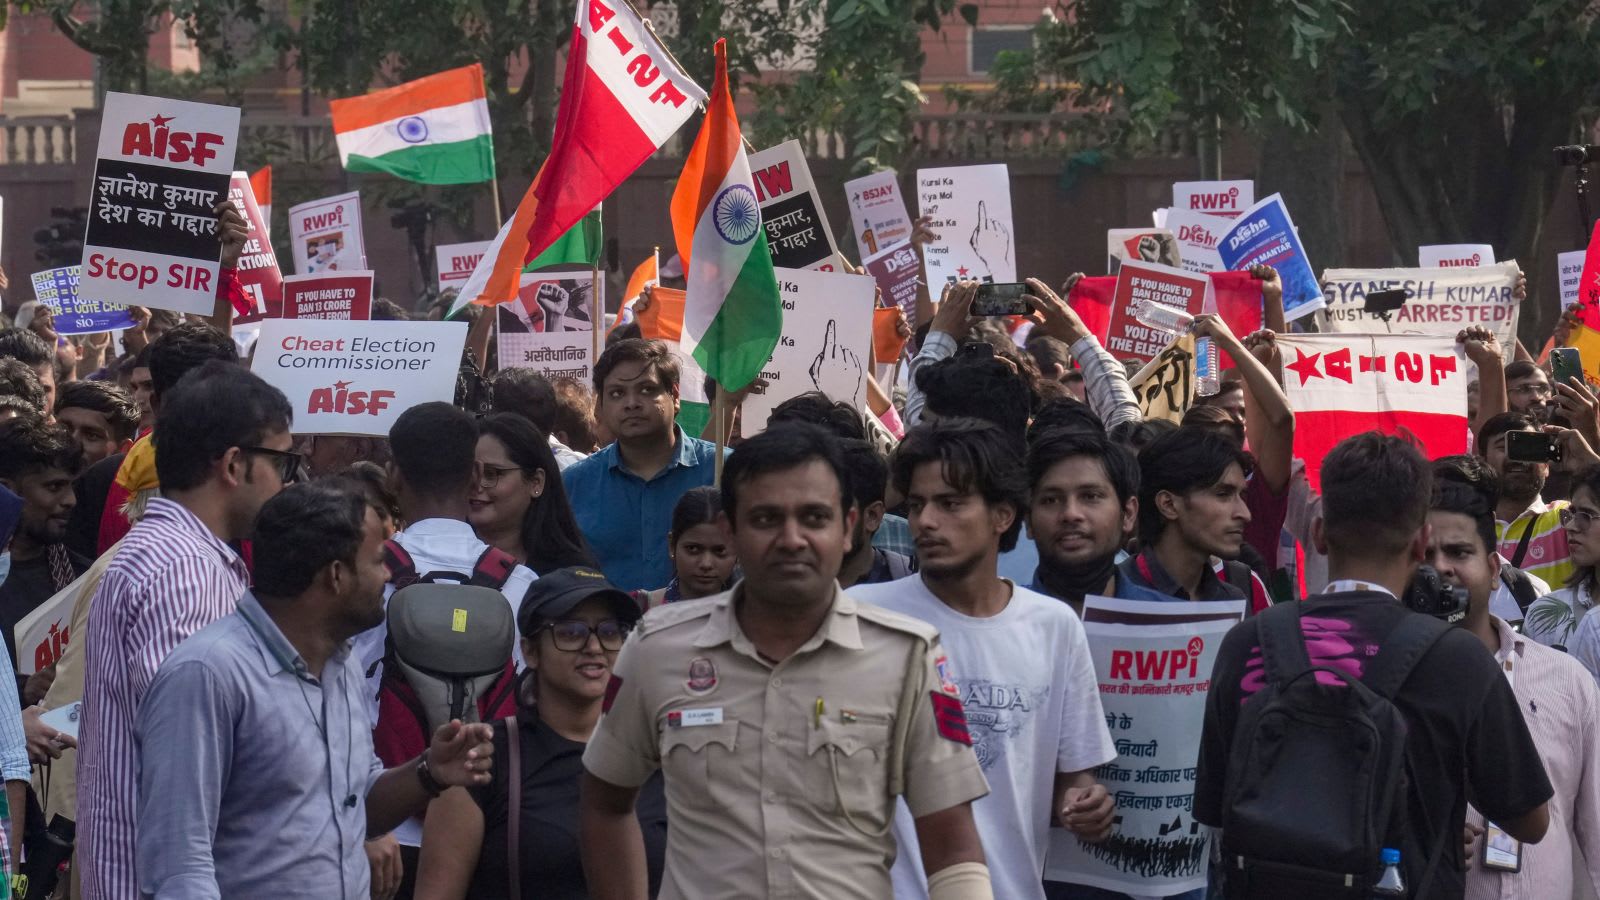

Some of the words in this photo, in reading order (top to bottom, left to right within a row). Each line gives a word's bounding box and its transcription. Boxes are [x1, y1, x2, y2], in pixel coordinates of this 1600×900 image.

[921, 178, 941, 187] Kursi
[942, 177, 953, 186] Ka
[98, 173, 158, 200] ज्ञानेश
[163, 184, 218, 209] कुमार
[922, 193, 937, 202] Kya
[939, 192, 953, 200] Mol
[98, 197, 132, 224] देश
[137, 207, 165, 228] का
[927, 220, 944, 228] anta
[946, 219, 957, 227] Ka
[926, 246, 949, 254] Anmol
[87, 253, 159, 289] Stop
[166, 263, 211, 292] SIR
[296, 292, 303, 302] IF
[304, 290, 319, 301] YOU
[320, 289, 343, 299] HAVE
[344, 288, 356, 298] TO
[785, 282, 798, 293] Ka
[1131, 277, 1140, 286] IF
[1140, 278, 1157, 290] YOU
[1158, 282, 1180, 294] HAVE
[1181, 286, 1192, 297] TO
[1445, 286, 1512, 304] KUMAR
[1132, 287, 1151, 299] BAN
[1152, 290, 1161, 300] 13
[1161, 292, 1188, 306] CRORE
[298, 303, 314, 313] BAN
[315, 302, 322, 312] 13
[323, 300, 352, 310] CRORE
[1324, 308, 1365, 322] MUST
[1396, 304, 1515, 326] ARRESTED!
[1125, 325, 1149, 339] YOU
[281, 336, 345, 351] Cheat
[351, 337, 436, 353] Election
[781, 336, 795, 347] Ka
[1110, 336, 1133, 352] THE
[277, 353, 431, 370] Commissioner
[963, 682, 1030, 712] ADA
[1118, 683, 1130, 696] की
[1119, 712, 1133, 730] के
[1115, 739, 1158, 757] नियादी
[1134, 766, 1181, 783] अधिकार
[1166, 794, 1194, 812] एकजु
